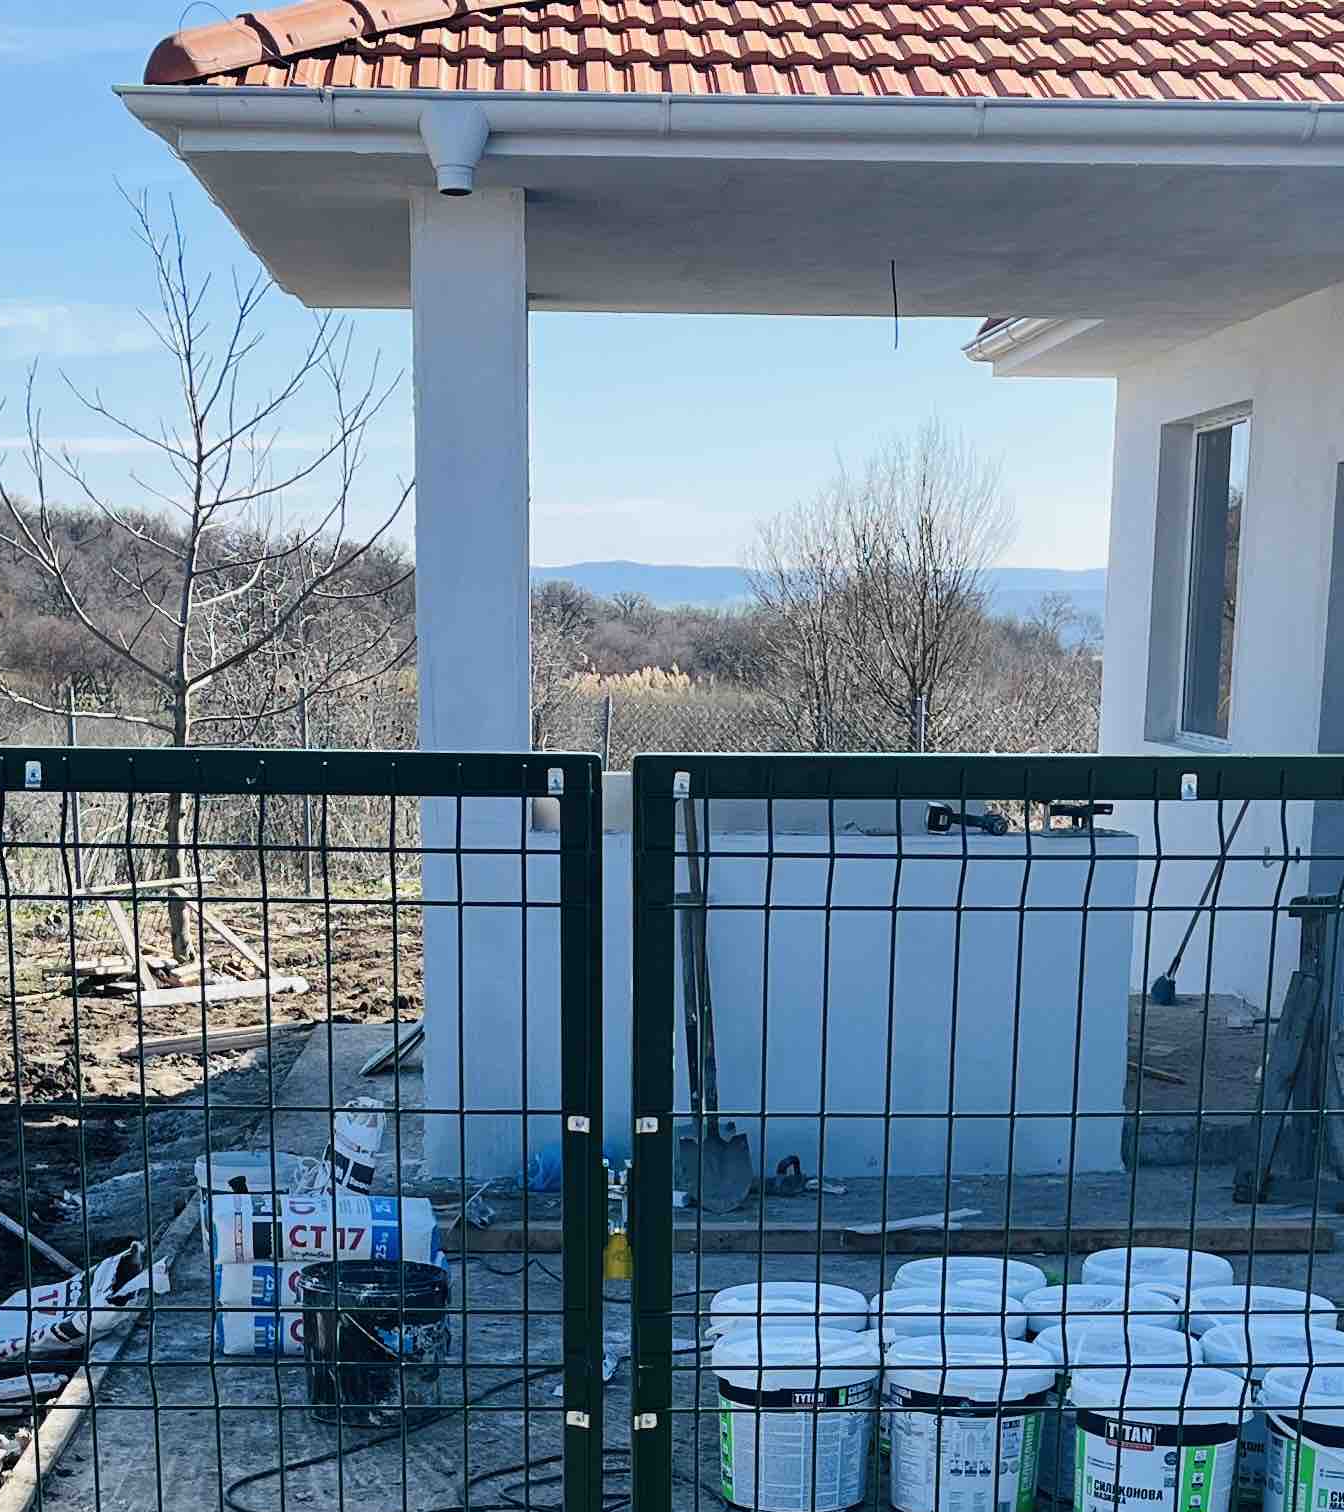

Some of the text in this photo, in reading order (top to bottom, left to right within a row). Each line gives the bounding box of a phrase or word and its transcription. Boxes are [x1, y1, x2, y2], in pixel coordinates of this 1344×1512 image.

[288, 1224, 367, 1250] CT 17
[794, 1392, 825, 1404] TYTN
